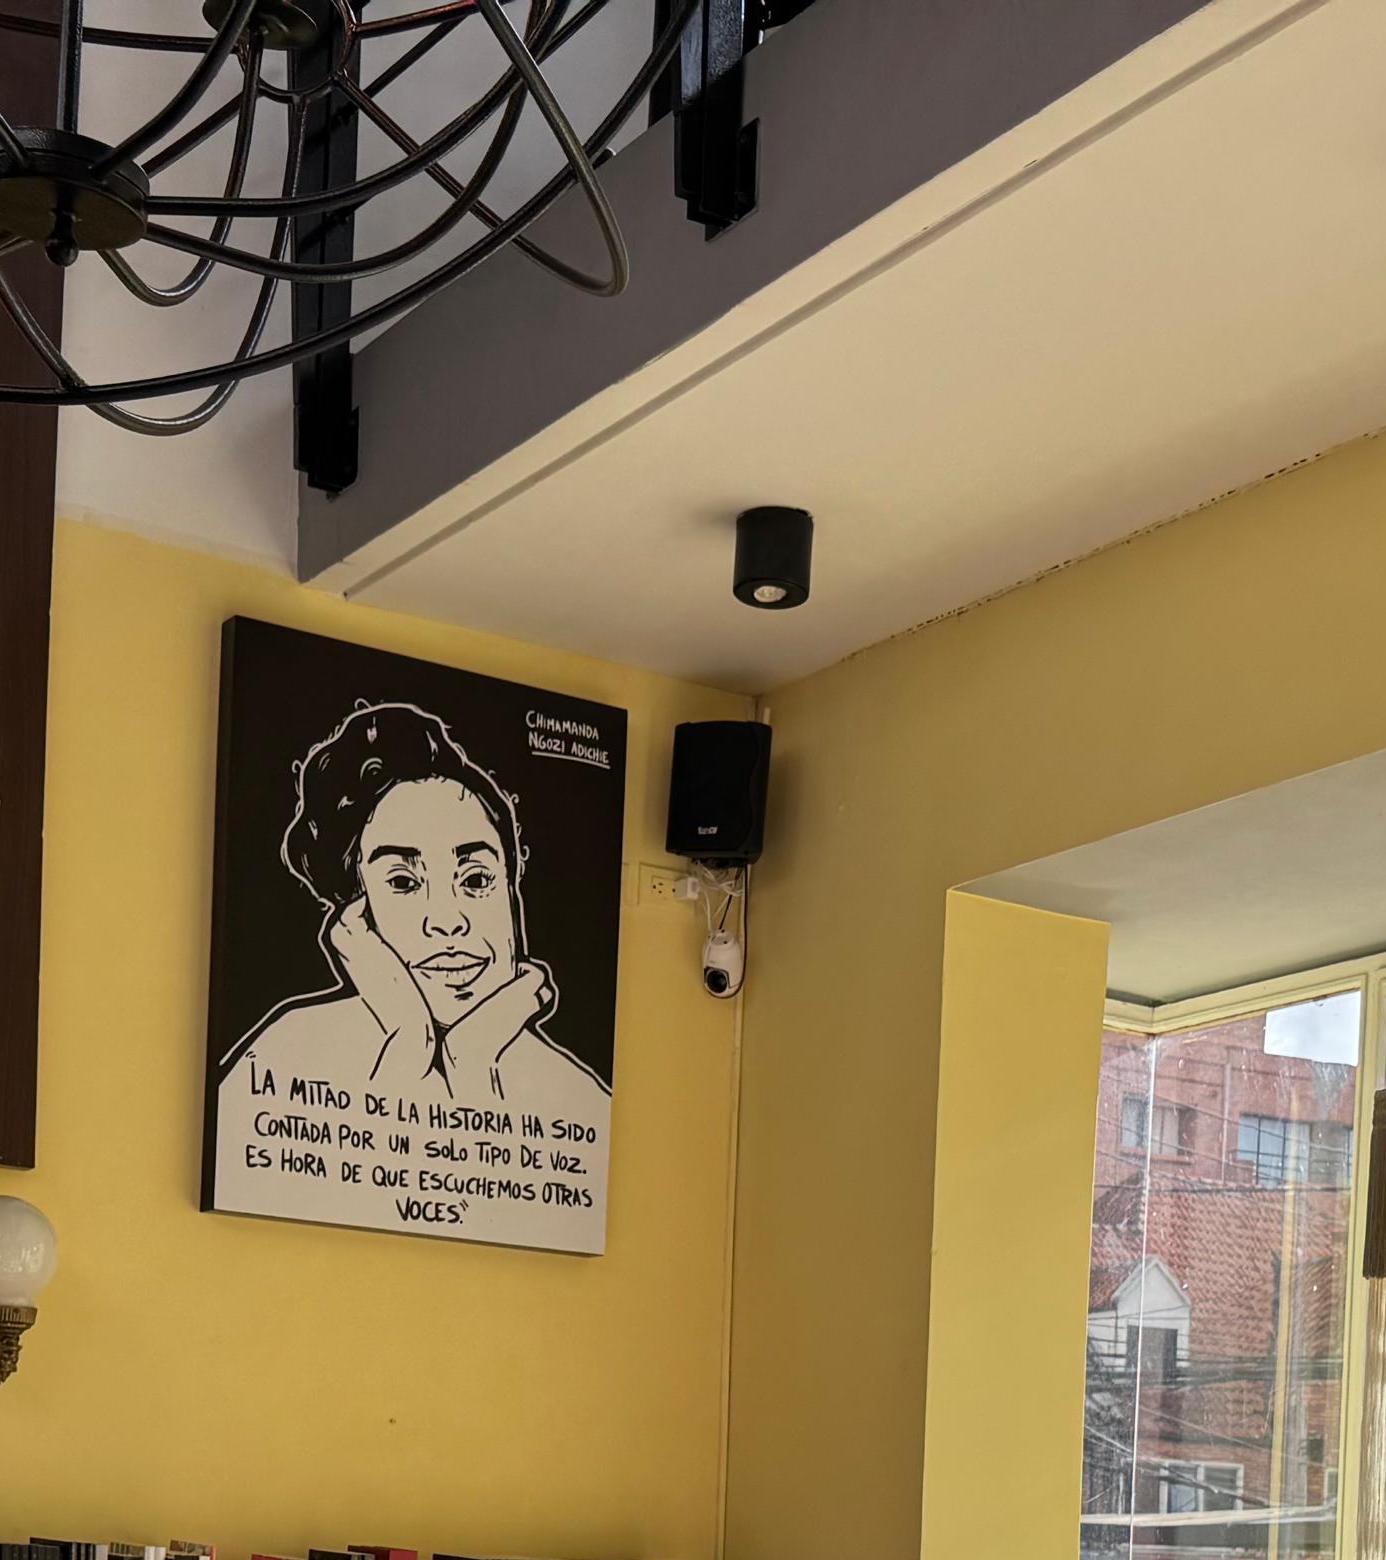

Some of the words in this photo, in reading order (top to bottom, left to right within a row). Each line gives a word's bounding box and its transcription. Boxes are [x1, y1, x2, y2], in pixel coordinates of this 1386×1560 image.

[526, 709, 601, 741] CHIMAMANDA
[528, 733, 566, 753] NGOZI
[570, 742, 611, 763] ADICHIE
[290, 1076, 352, 1112] MITAD
[365, 1093, 391, 1119] DE
[397, 1098, 421, 1126] LA
[429, 1103, 514, 1136] HISTORIA
[522, 1113, 545, 1140] HA
[551, 1118, 597, 1146] SIDO
[255, 1111, 333, 1146] CONTADA
[338, 1121, 376, 1151] POR
[388, 1134, 411, 1156] UN
[424, 1137, 469, 1164] SOLO
[477, 1140, 512, 1167] TIPO
[520, 1147, 544, 1170] DE
[550, 1150, 589, 1176] VOZ.
[245, 1145, 272, 1170] ES
[280, 1150, 328, 1180] HORA
[341, 1161, 364, 1185] DE
[372, 1164, 410, 1190] QUE
[419, 1172, 538, 1203] ESCUCHEMOS
[542, 1182, 594, 1209] OTRAS
